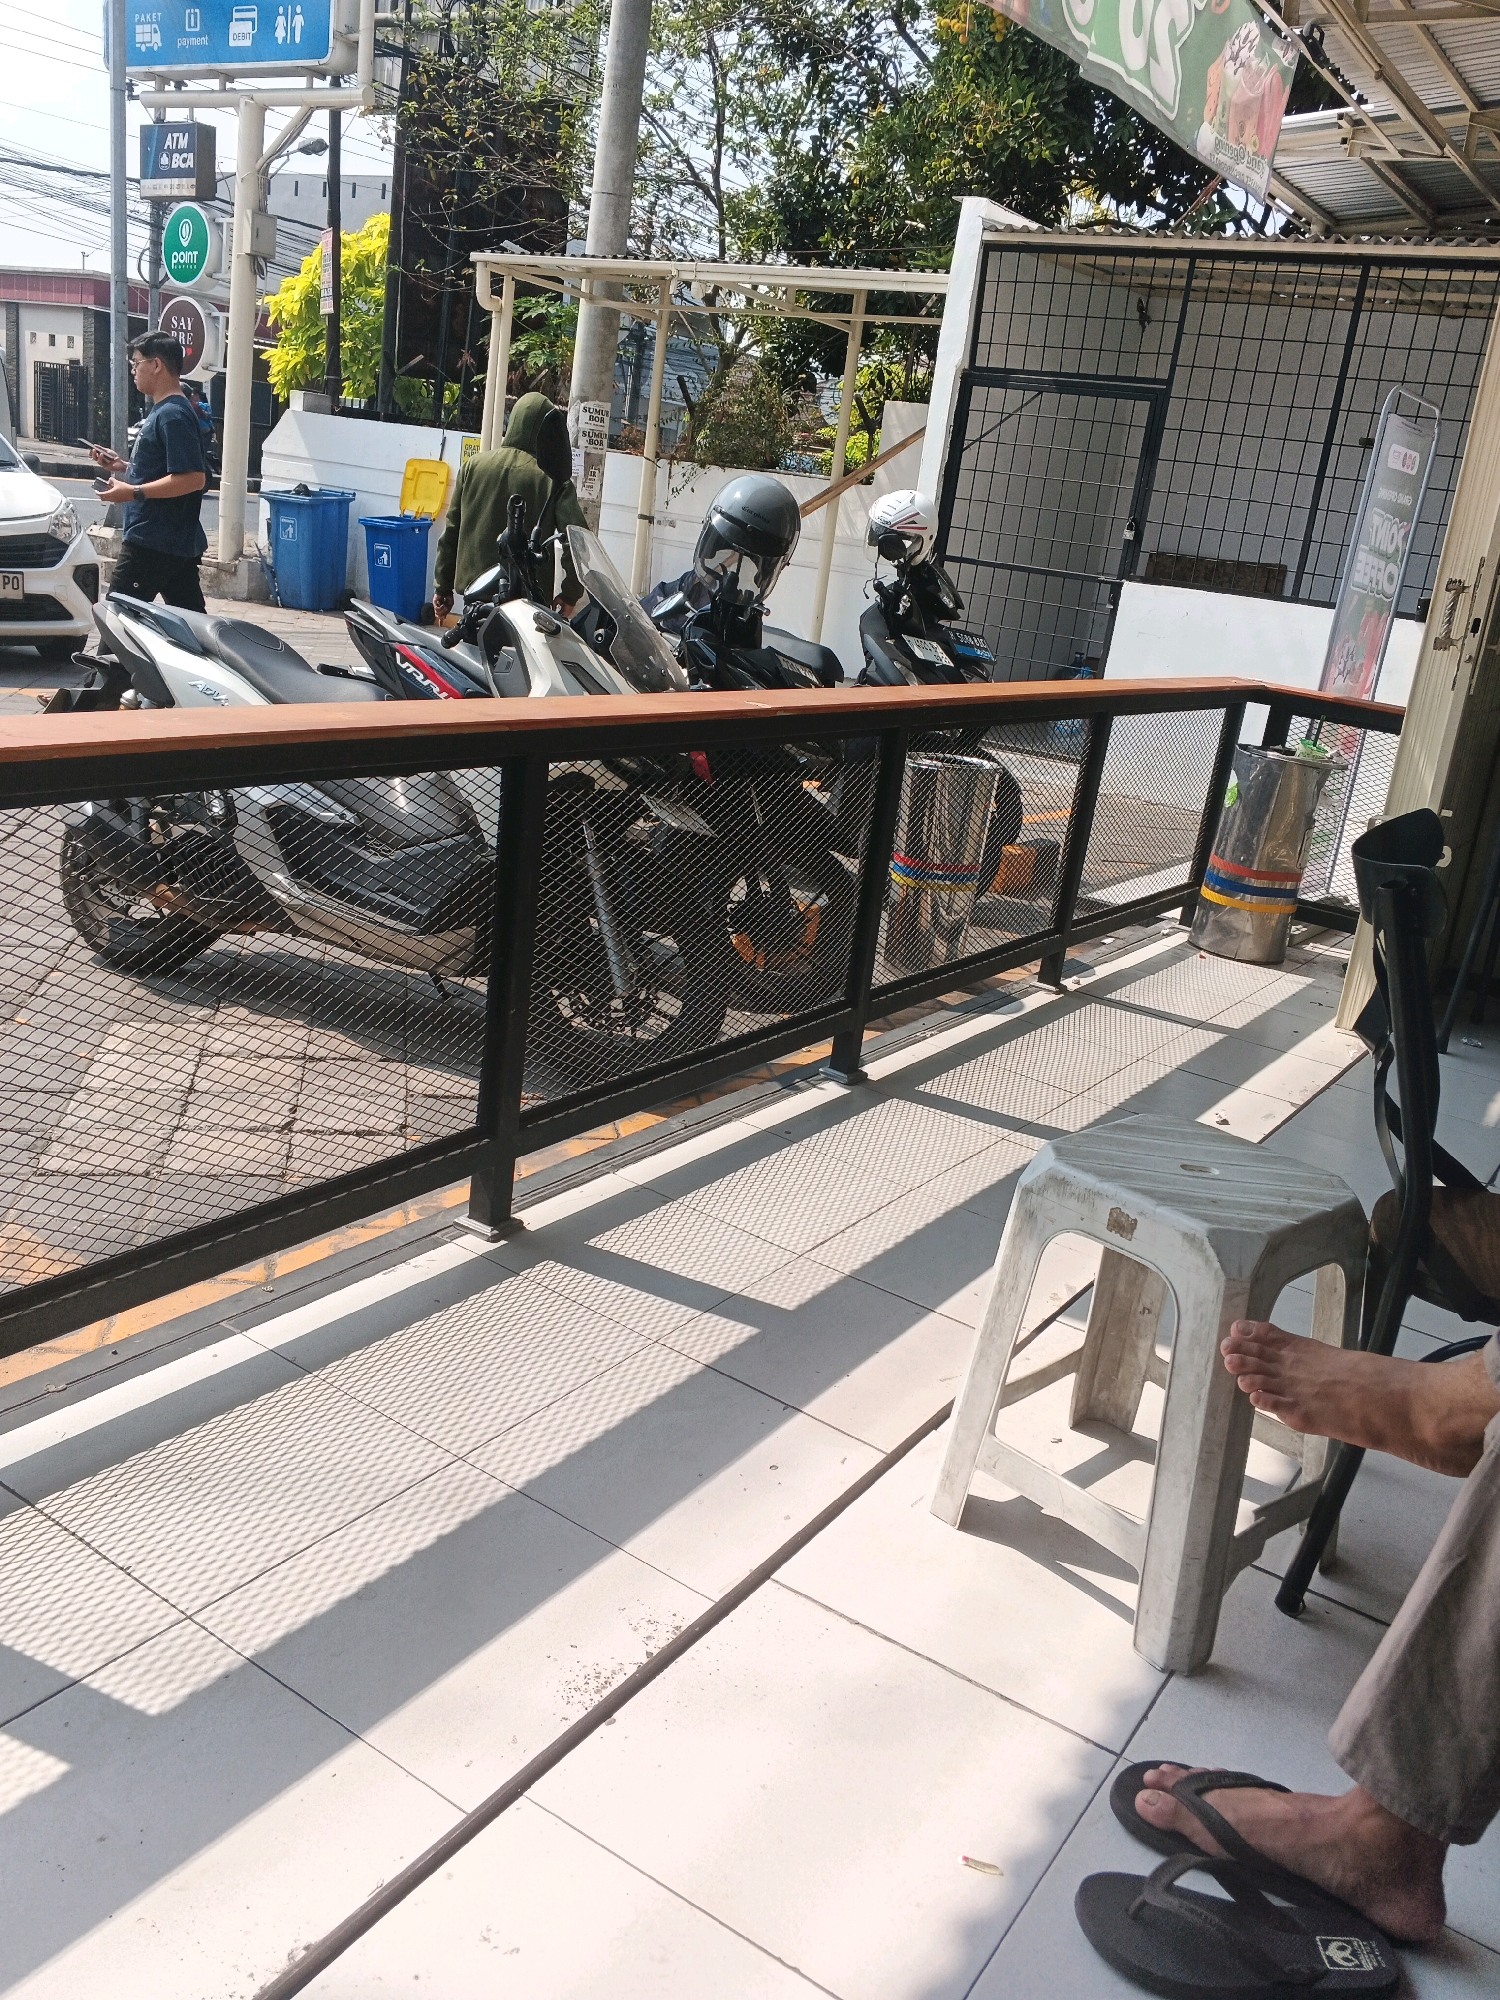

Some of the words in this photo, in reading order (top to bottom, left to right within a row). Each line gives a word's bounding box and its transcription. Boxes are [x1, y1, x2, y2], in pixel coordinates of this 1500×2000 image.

[134, 12, 162, 23] PAKET
[177, 35, 209, 48] payment
[232, 32, 251, 41] DEBIT
[163, 132, 189, 150] ATM
[171, 152, 194, 169] BCA
[171, 315, 194, 331] SAY
[588, 414, 605, 424] BOR
[588, 438, 604, 447] BOR
